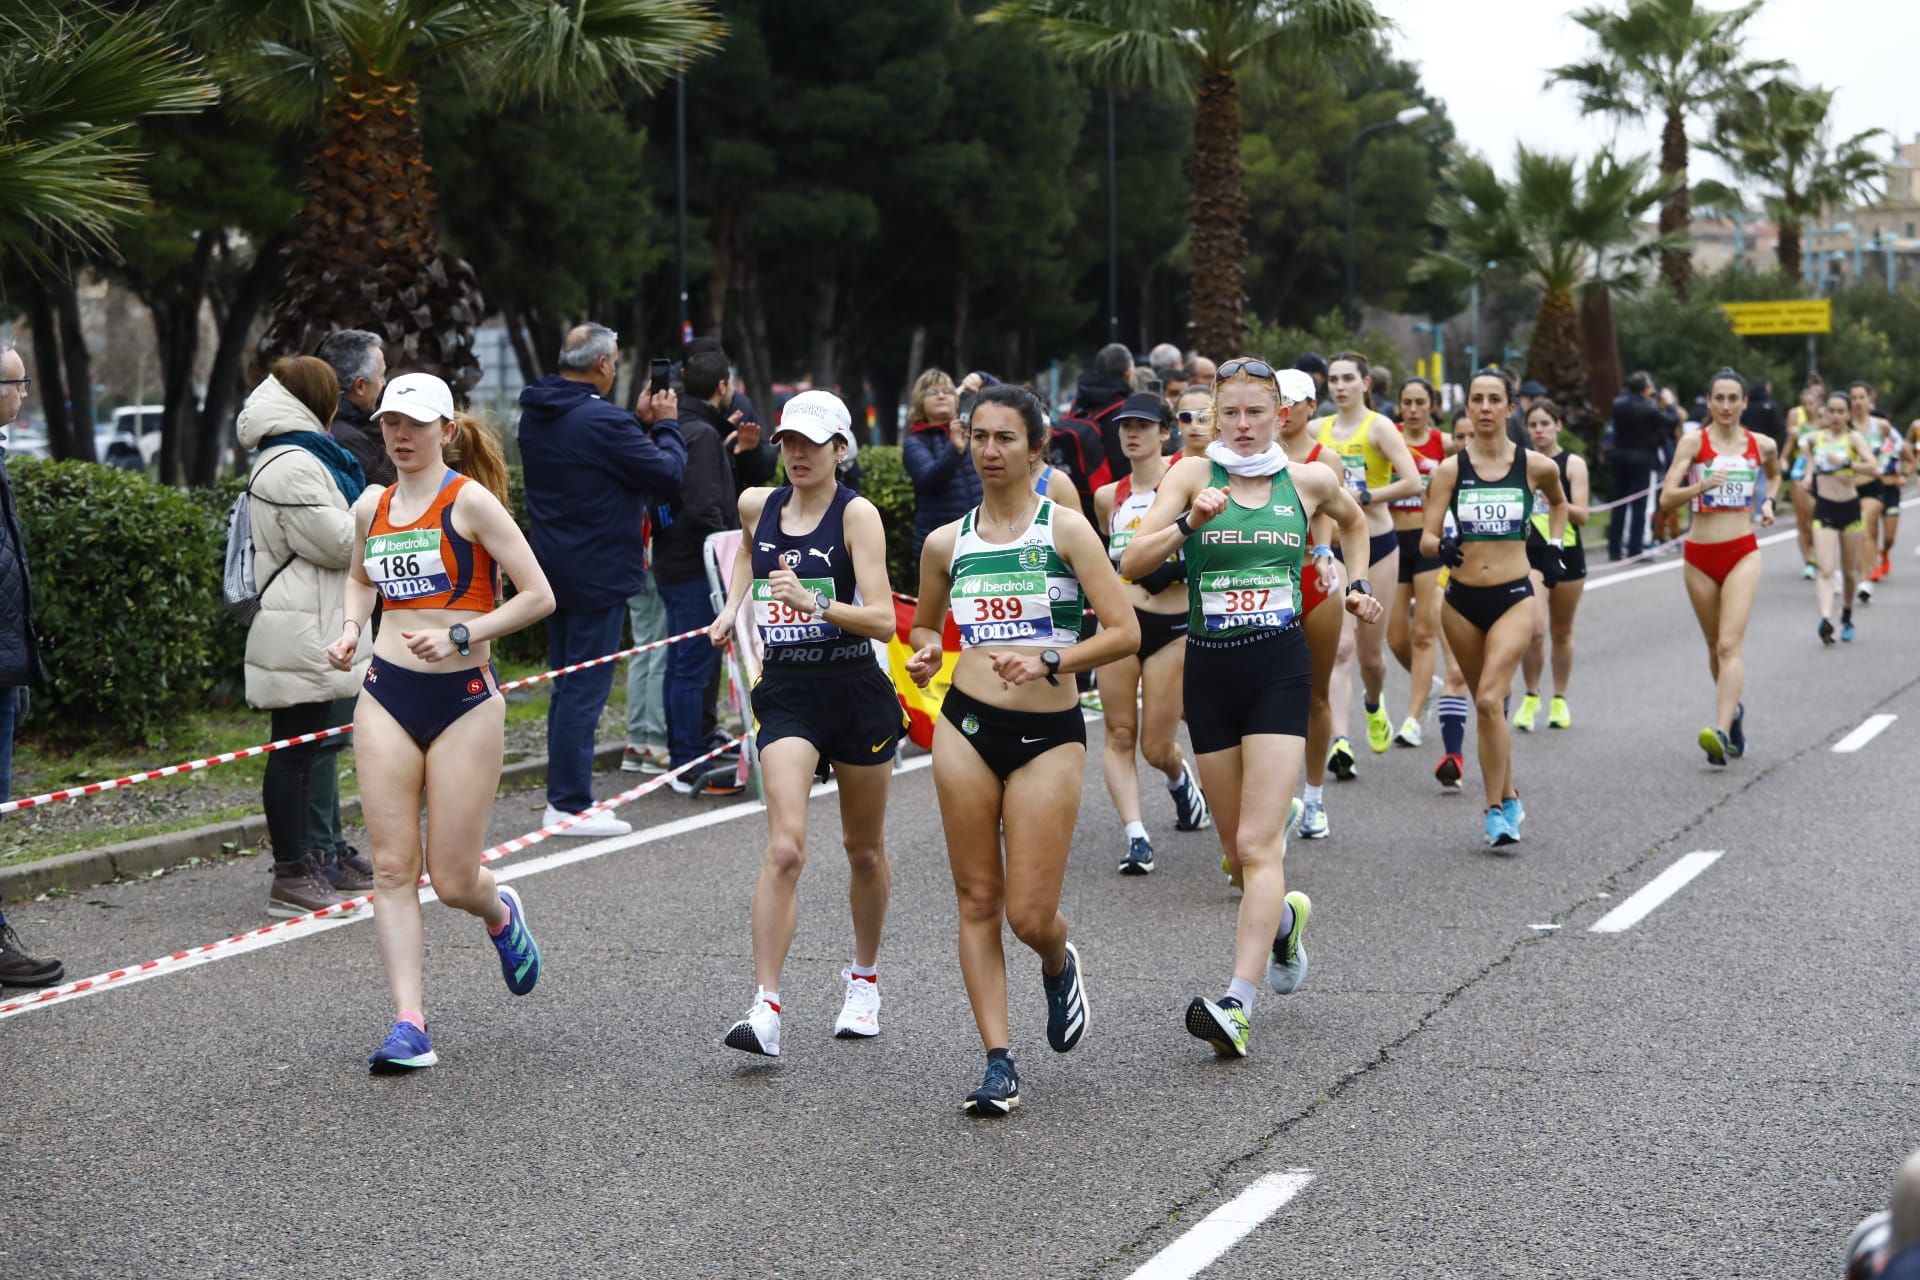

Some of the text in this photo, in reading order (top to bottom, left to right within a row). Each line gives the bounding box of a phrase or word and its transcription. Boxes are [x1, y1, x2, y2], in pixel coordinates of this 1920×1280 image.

[1473, 504, 1507, 519] 190
[386, 538, 429, 551] Iberdrola
[1201, 531, 1301, 548] IRELAND
[379, 554, 420, 579] 186
[982, 580, 1034, 593] Iberdrola
[1232, 574, 1281, 587] Iberdrola
[973, 597, 1023, 622] 389
[1225, 589, 1270, 613] 387
[1219, 612, 1281, 630] Joma
[764, 625, 825, 644] Joma
[969, 621, 1037, 645] Joma
[778, 648, 823, 662] PRO
[830, 641, 869, 661] PRO
[1196, 640, 1229, 648] ARMOUR
